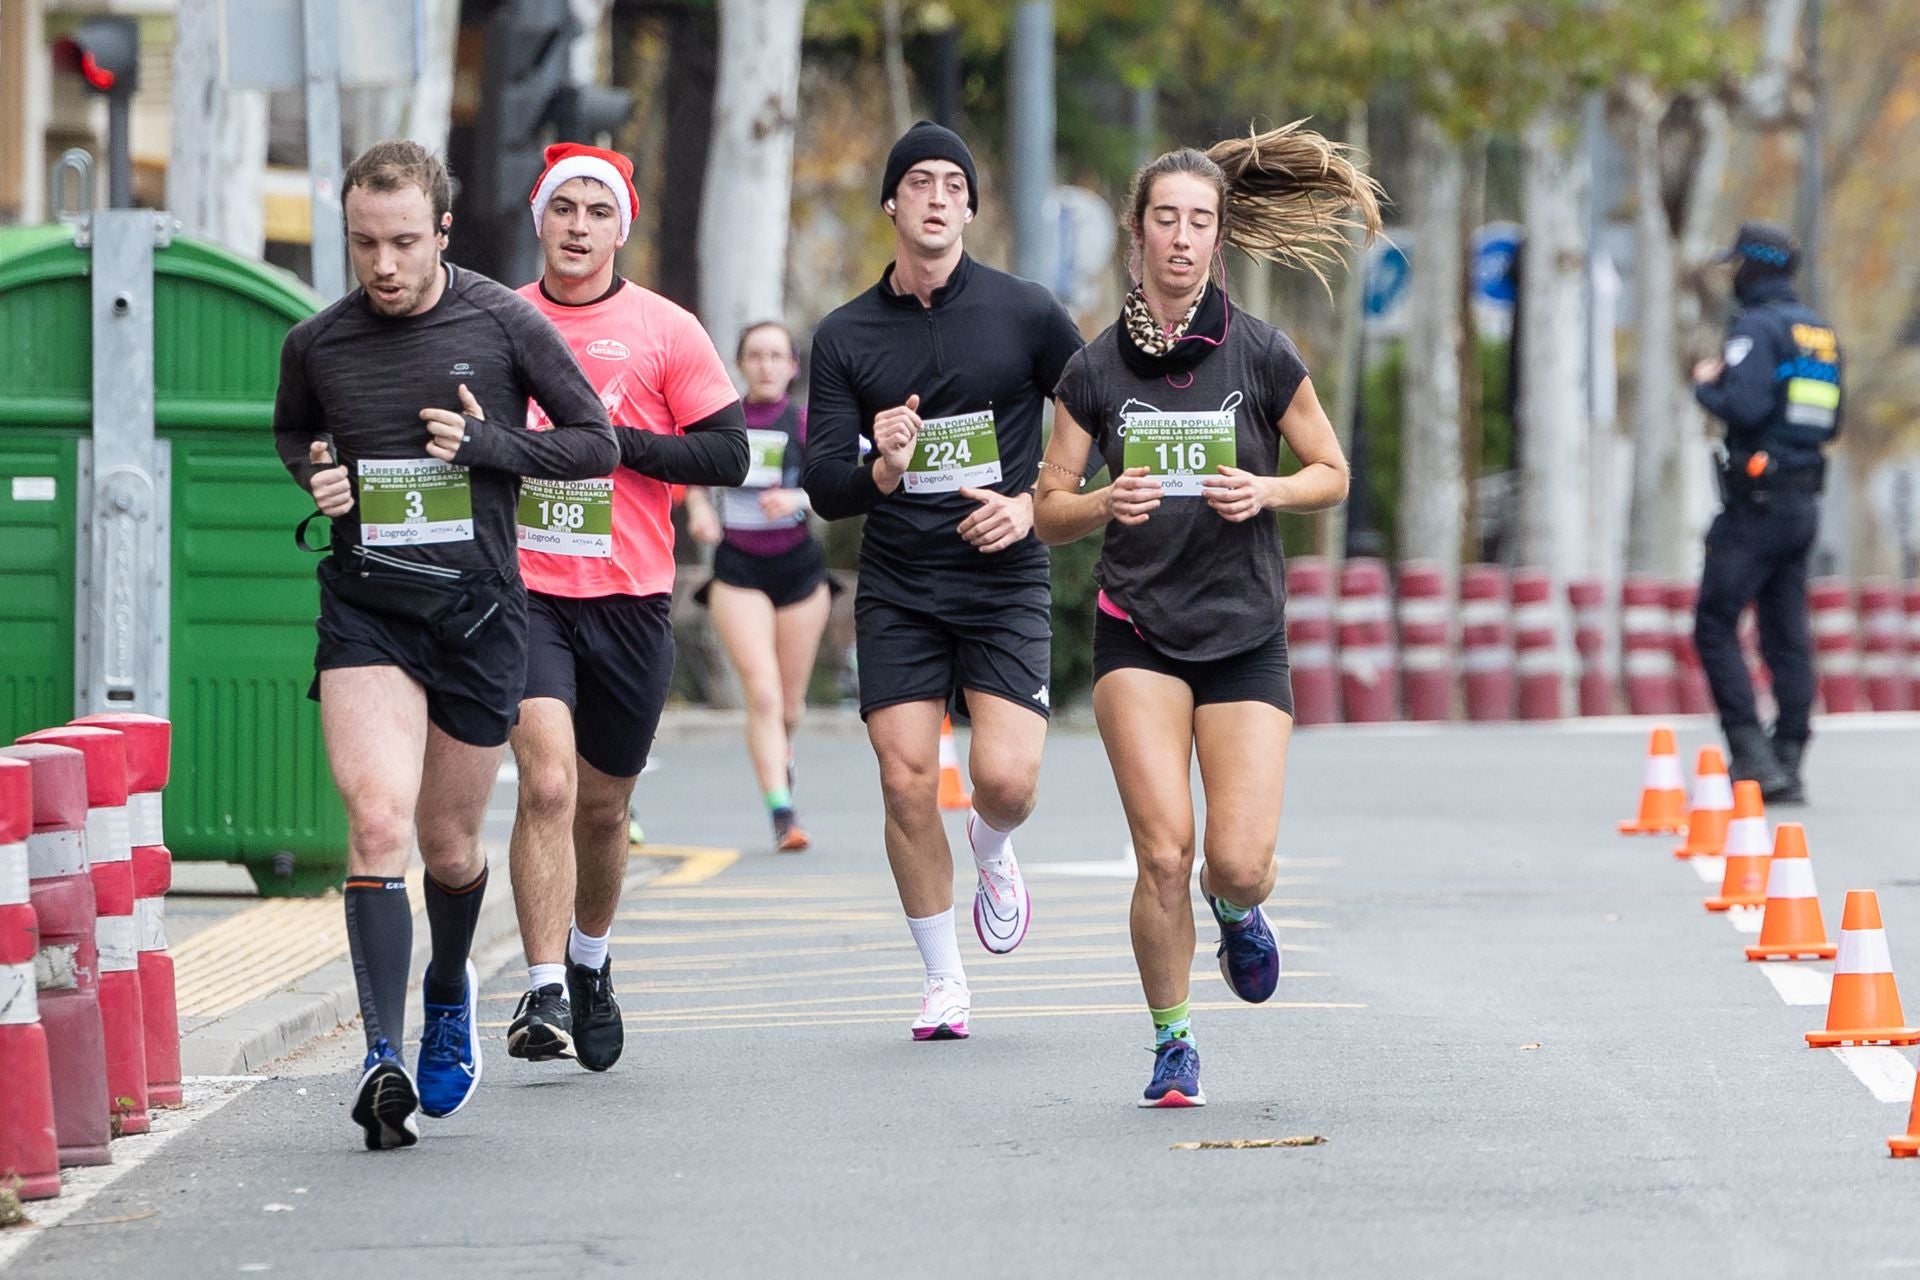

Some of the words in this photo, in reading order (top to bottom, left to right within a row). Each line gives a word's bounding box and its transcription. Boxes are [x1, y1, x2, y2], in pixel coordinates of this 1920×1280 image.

[948, 423, 990, 434] ESPERANZA
[1130, 419, 1178, 427] CARRERA
[1181, 419, 1231, 427] POPULAR
[924, 438, 972, 467] 224
[1155, 442, 1206, 470] 116
[363, 467, 411, 475] CARRERA
[413, 464, 466, 475] POPULAR
[364, 476, 392, 484] VIRGEN
[417, 473, 464, 482] ESPERANZA
[920, 474, 953, 484] Logroño
[1161, 479, 1183, 488] roño
[563, 480, 610, 490] POPULAR
[566, 490, 608, 498] ESPERANZA
[405, 490, 424, 518] 3
[538, 500, 584, 529] 198
[380, 527, 418, 539] Logroño
[527, 531, 561, 544] Logroño
